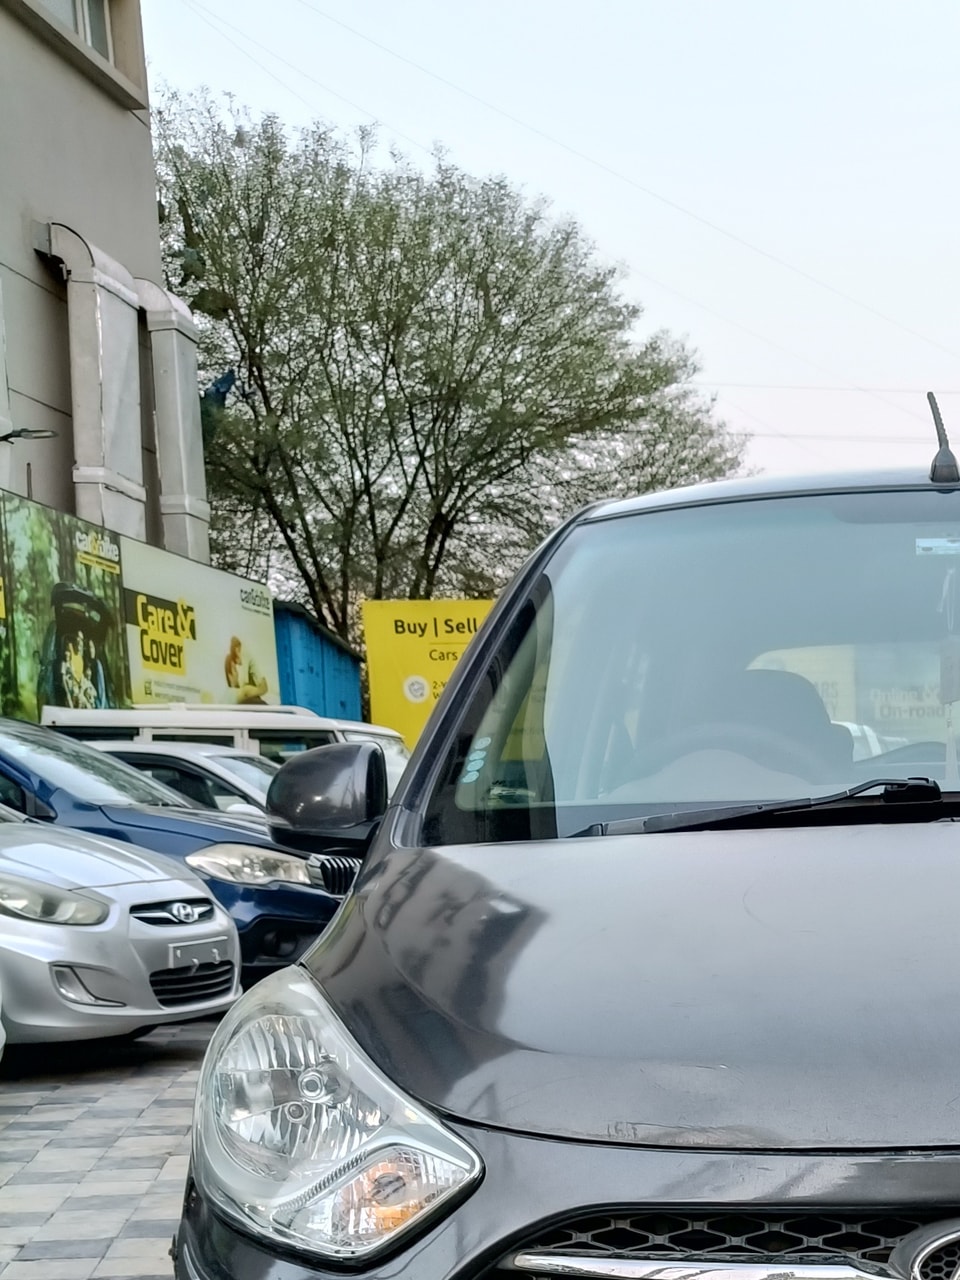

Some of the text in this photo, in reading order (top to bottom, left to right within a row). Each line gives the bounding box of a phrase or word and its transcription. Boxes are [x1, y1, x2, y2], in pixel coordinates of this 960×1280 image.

[137, 595, 175, 635] Care
[394, 619, 427, 638] Buy
[444, 618, 478, 634] Sell
[140, 629, 184, 668] Cover
[429, 649, 458, 661] Cars
